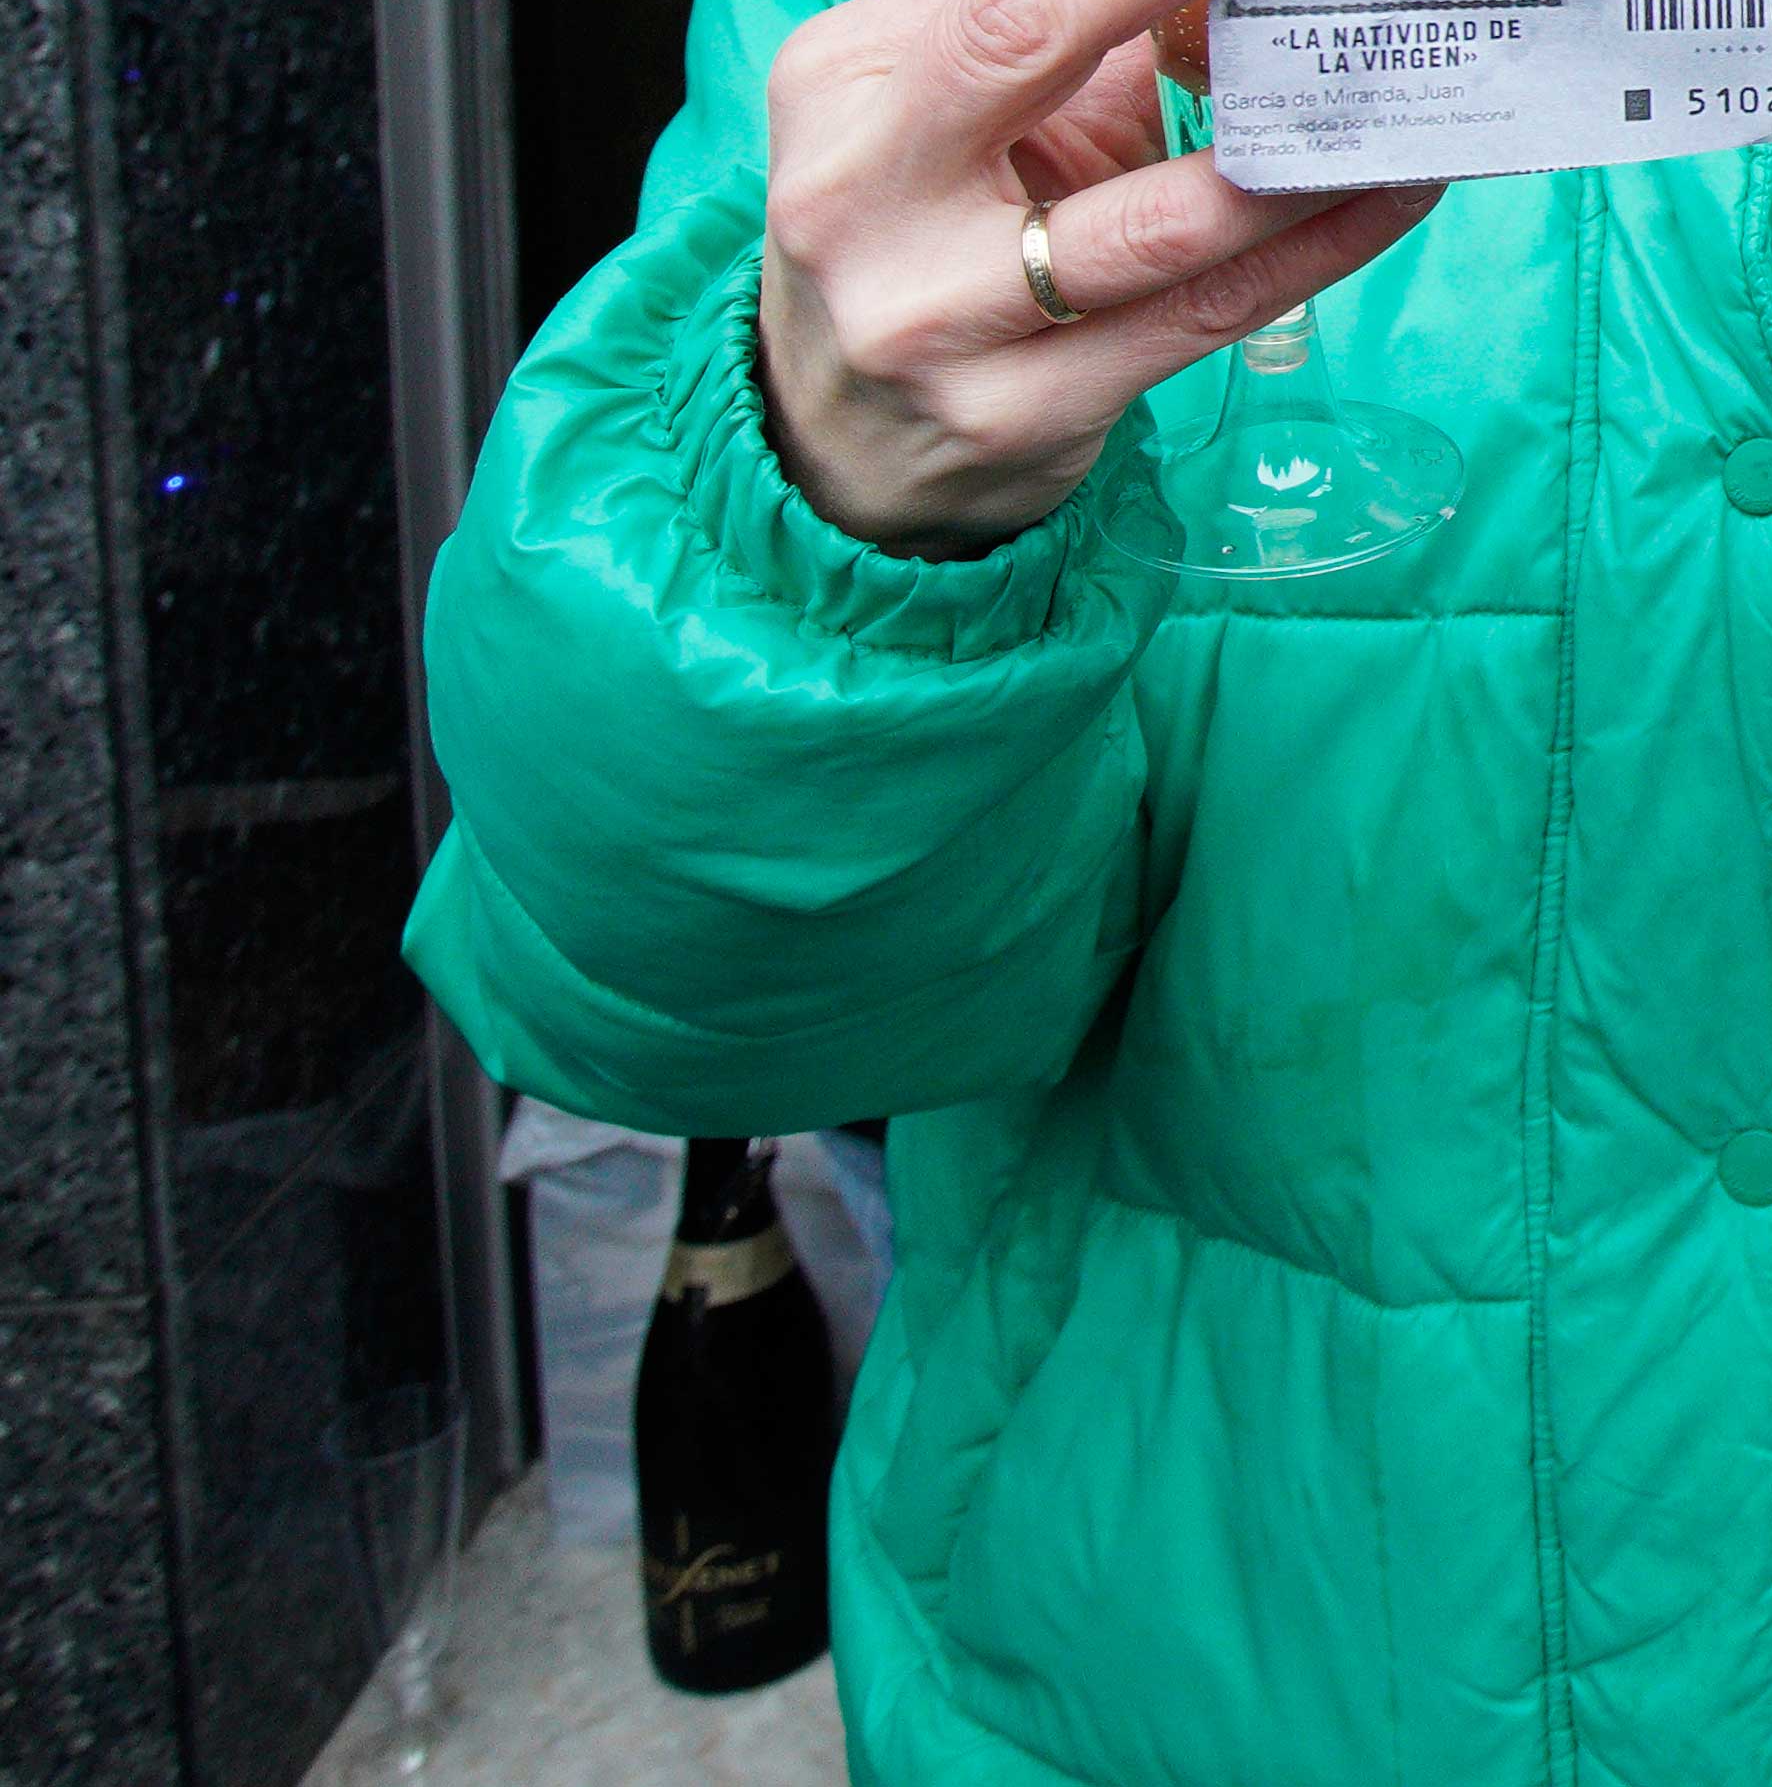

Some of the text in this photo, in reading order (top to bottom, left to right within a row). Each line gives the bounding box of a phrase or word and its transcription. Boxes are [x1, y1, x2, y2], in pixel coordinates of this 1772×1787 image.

[1332, 20, 1477, 49] NATIVIDAD
[1489, 18, 1522, 40] DE
[1319, 53, 1350, 74] LA
[1221, 83, 1465, 111] García de Miranda, Juan
[1342, 118, 1370, 134] por
[1450, 109, 1516, 125] Nacional
[1221, 141, 1247, 158] del
